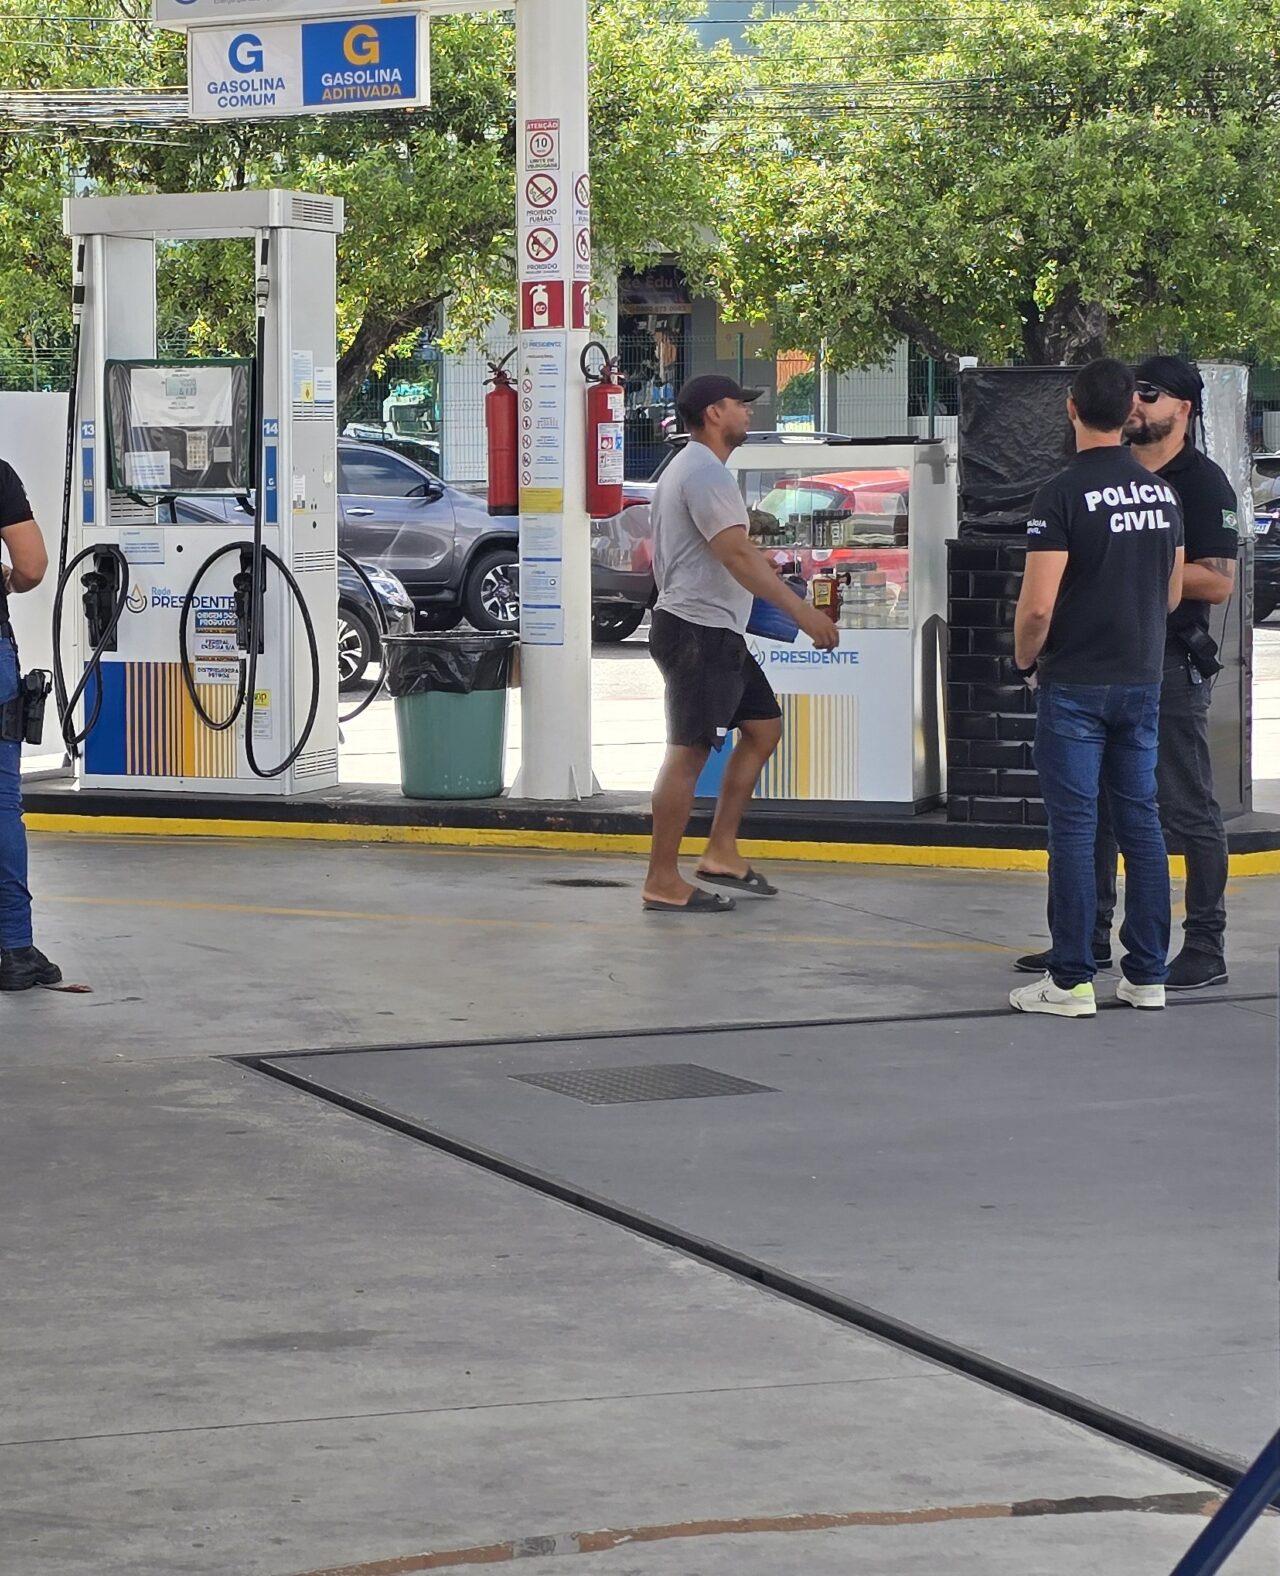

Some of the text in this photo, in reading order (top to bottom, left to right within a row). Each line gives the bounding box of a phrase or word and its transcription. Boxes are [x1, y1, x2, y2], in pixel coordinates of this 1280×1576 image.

[343, 24, 380, 66] G
[228, 33, 264, 74] G
[321, 67, 402, 86] GASOLINA
[207, 77, 286, 95] GASOLINA
[322, 84, 402, 101] ADITIVADA
[217, 93, 276, 109] COMUM
[527, 121, 558, 130] ATENÇÃO
[535, 137, 548, 148] 10
[82, 424, 95, 436] 13
[264, 422, 279, 435] 14
[1084, 481, 1177, 512] POLÍCIA
[1110, 509, 1171, 533] CIVIL
[151, 595, 237, 608] PRESDENTE
[770, 650, 859, 664] PRESIDENTE
